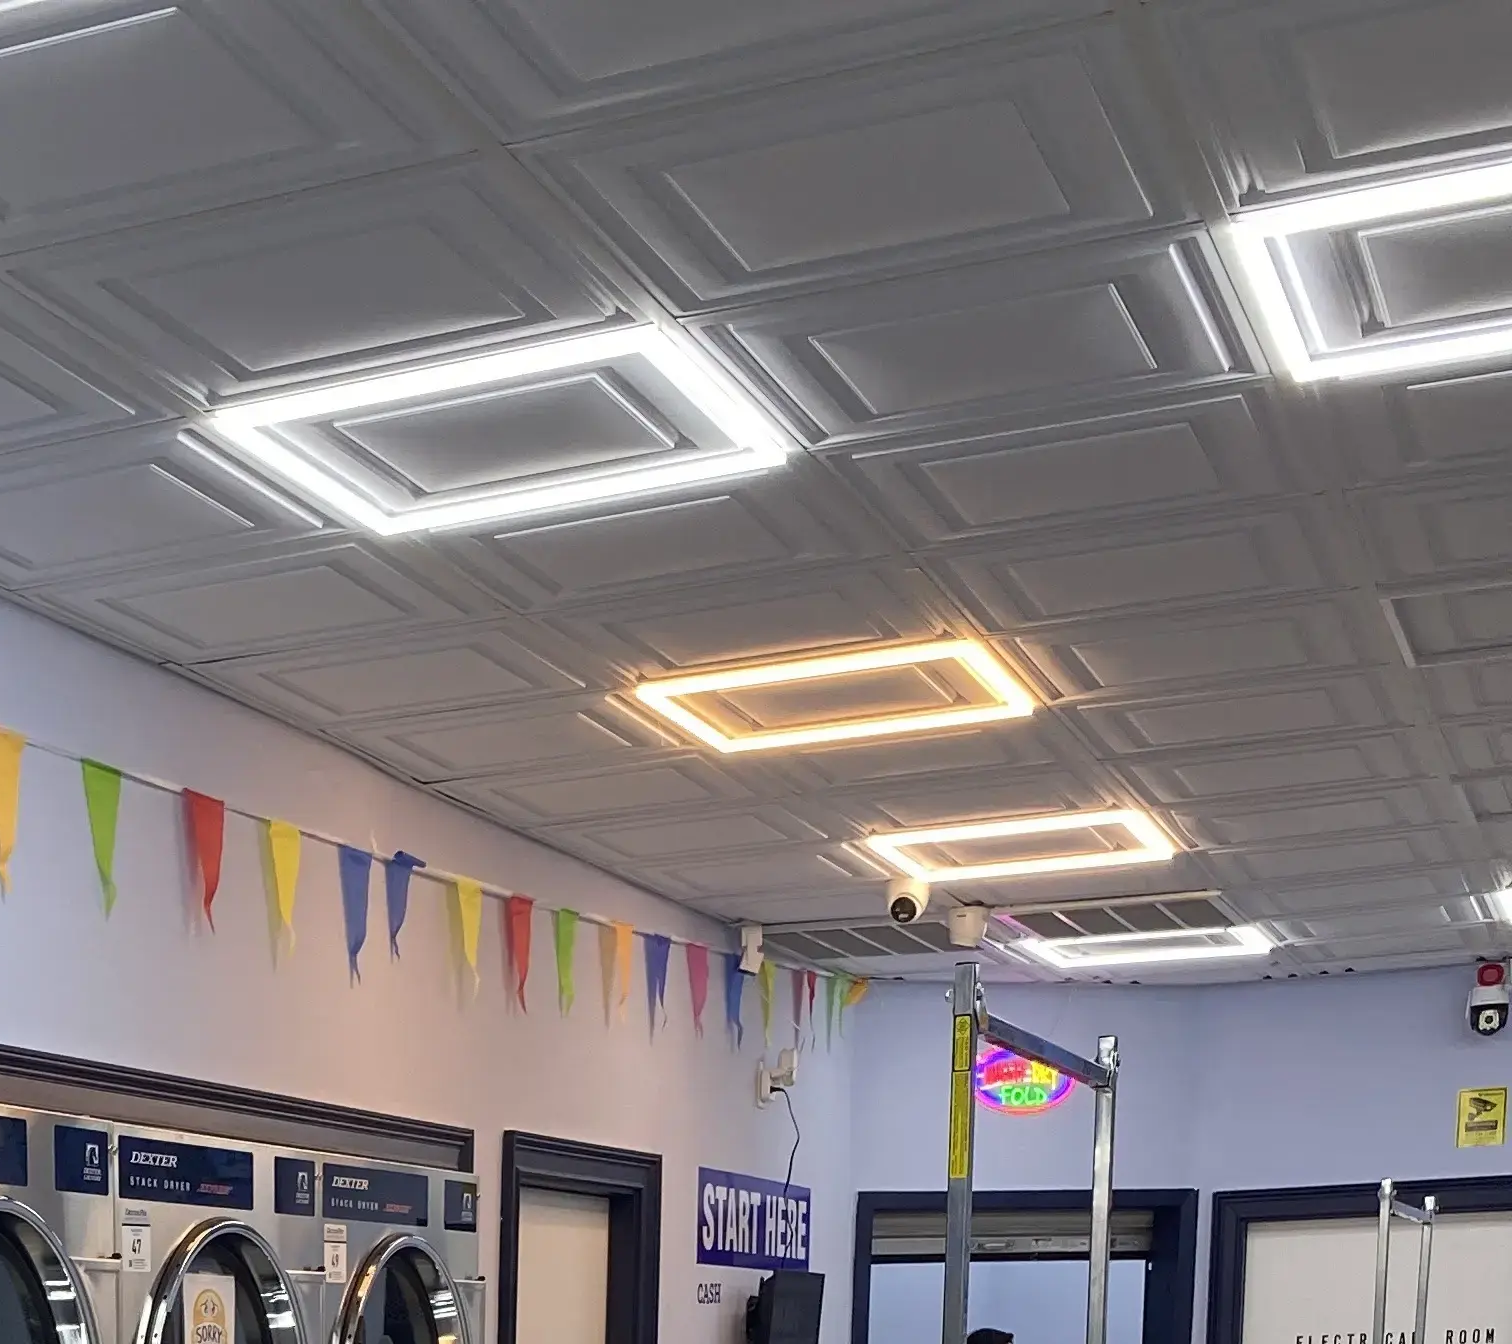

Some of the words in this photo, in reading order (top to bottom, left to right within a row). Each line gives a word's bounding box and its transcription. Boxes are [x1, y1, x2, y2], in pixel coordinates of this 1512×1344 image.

[999, 1085, 1048, 1106] FOLD
[130, 1151, 177, 1168] DEXTER
[129, 1176, 158, 1188] STACK
[164, 1180, 190, 1191] DRYER
[332, 1176, 369, 1190] DEXTER
[702, 1183, 761, 1255] START
[765, 1195, 807, 1260] HERE
[697, 1283, 721, 1304] CASH
[196, 1324, 223, 1344] SORRY
[1445, 1328, 1495, 1344] ROOM
